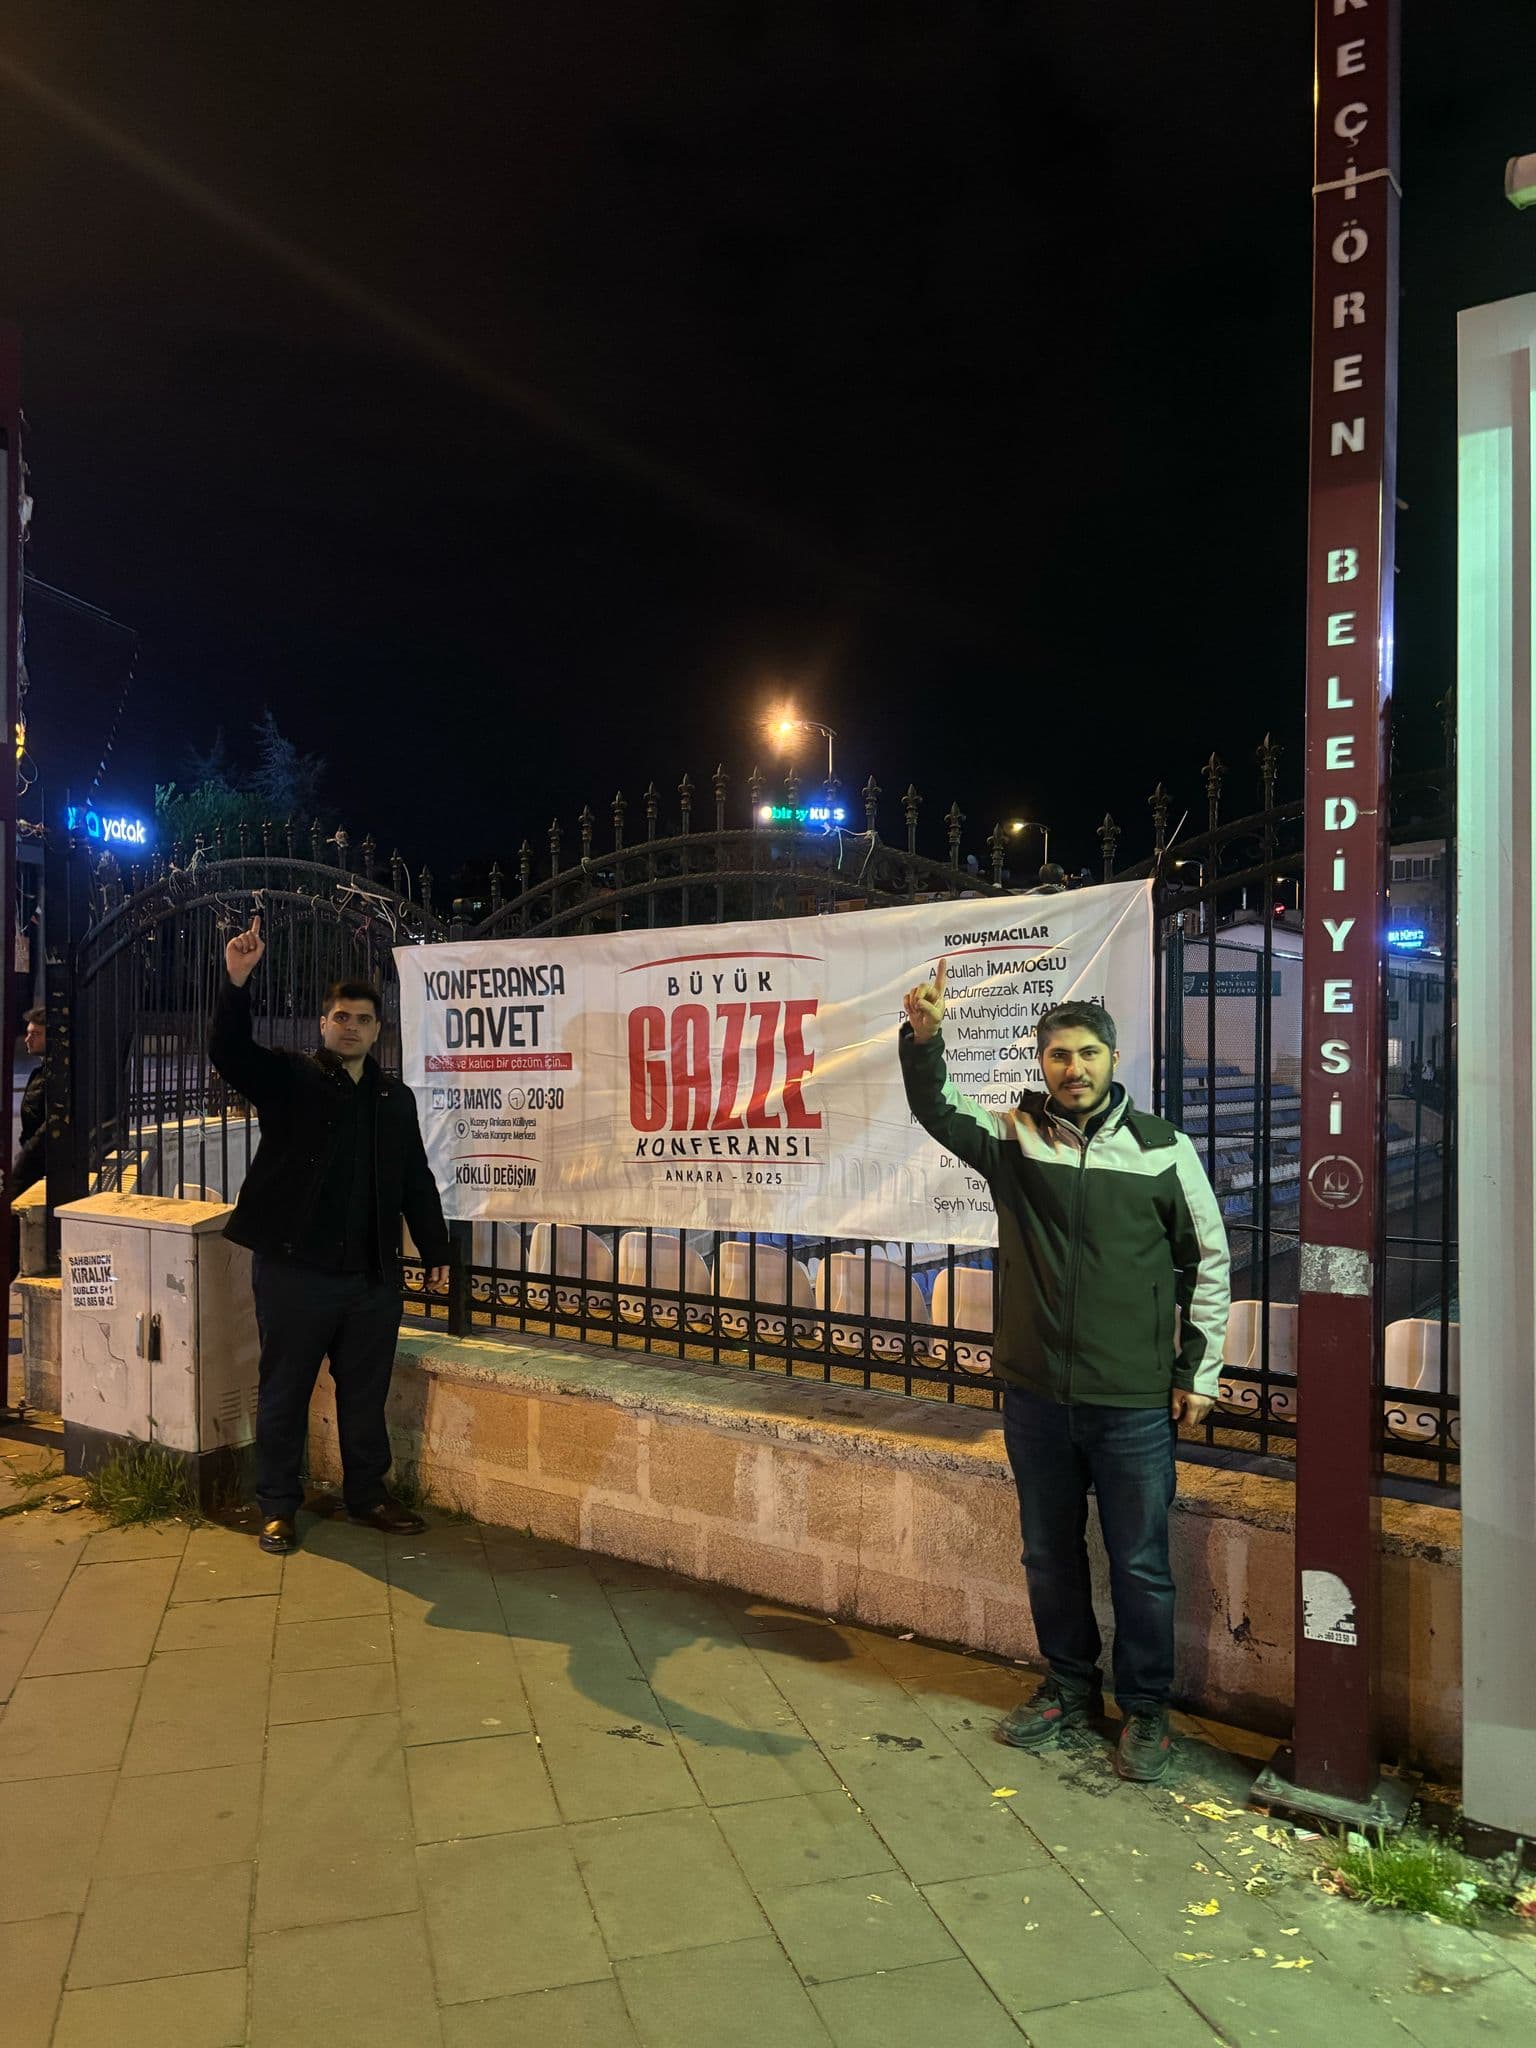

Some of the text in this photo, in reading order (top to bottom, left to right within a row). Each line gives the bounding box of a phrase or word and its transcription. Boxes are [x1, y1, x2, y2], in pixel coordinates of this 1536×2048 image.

[810, 807, 844, 820] KUS
[102, 817, 146, 844] yatak
[1321, 548, 1359, 1135] BELEDİYESİ
[944, 926, 1049, 947] KONUŞMACILAR
[929, 956, 1067, 979] Adullah İMAMOĞLU
[424, 964, 566, 1000] KONFERANSA
[667, 968, 773, 997] BÜYÜK
[943, 980, 1054, 1000] Abdurrezzak ATEŞ
[960, 1004, 1028, 1021] Muhyiddin
[446, 1005, 545, 1049] DAVET
[958, 1026, 1010, 1040] Mahmut
[496, 1057, 508, 1068] bir
[511, 1057, 543, 1070] çözüm
[946, 1048, 996, 1061] Mehmet
[627, 999, 823, 1133] GAZZE
[993, 1069, 1021, 1083] Emin
[464, 1088, 502, 1109] MAYIS
[528, 1088, 564, 1109] 20:30
[470, 1118, 488, 1129] Kuzey
[490, 1131, 512, 1142] Kongre
[635, 1135, 810, 1157] KONFERANSI
[940, 1154, 954, 1168] Dr.
[455, 1164, 536, 1188] KÖKLÜ DEĞİŞİM
[666, 1169, 723, 1184] ANKARA
[746, 1171, 783, 1185] 2025
[934, 1196, 965, 1213] Şeyh
